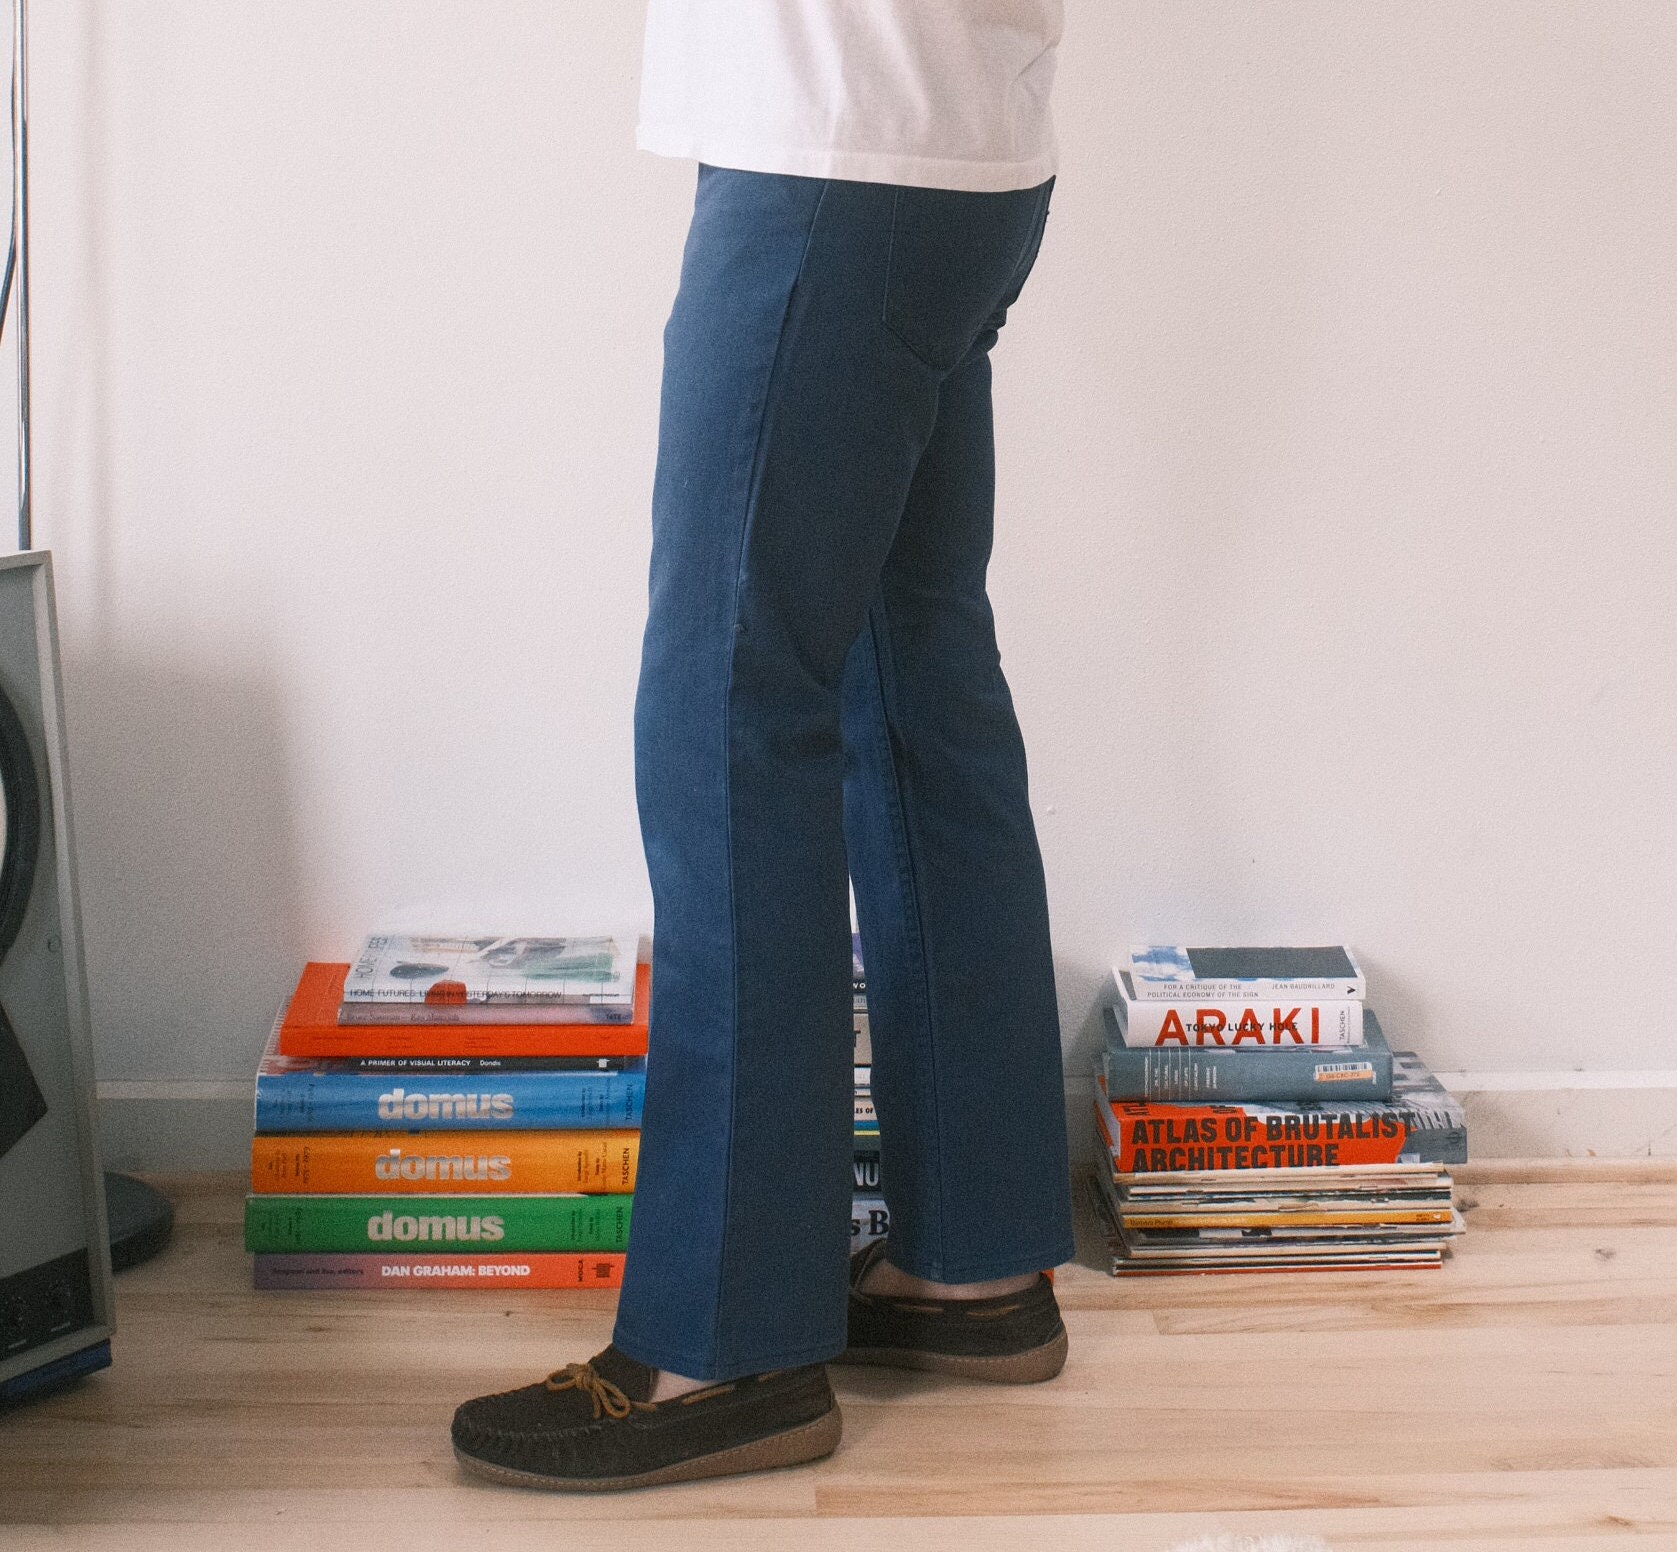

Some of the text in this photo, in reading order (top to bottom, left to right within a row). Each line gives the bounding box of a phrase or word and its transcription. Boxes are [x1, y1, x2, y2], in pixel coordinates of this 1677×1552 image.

[350, 989, 374, 997] HOME
[1154, 1007, 1320, 1047] ARAKI
[1186, 1022, 1298, 1033] TOKYO LUCKY HOLE
[378, 1089, 514, 1120] domus
[1132, 1110, 1416, 1144] ATLAS OF BRUTALIST
[375, 1148, 512, 1182] domus
[622, 1147, 630, 1185] TASCHEN
[1132, 1144, 1339, 1173] ARCHITECTURE
[367, 1210, 505, 1241] domus
[381, 1265, 531, 1278] DAN GRAHAM: BEYOND
